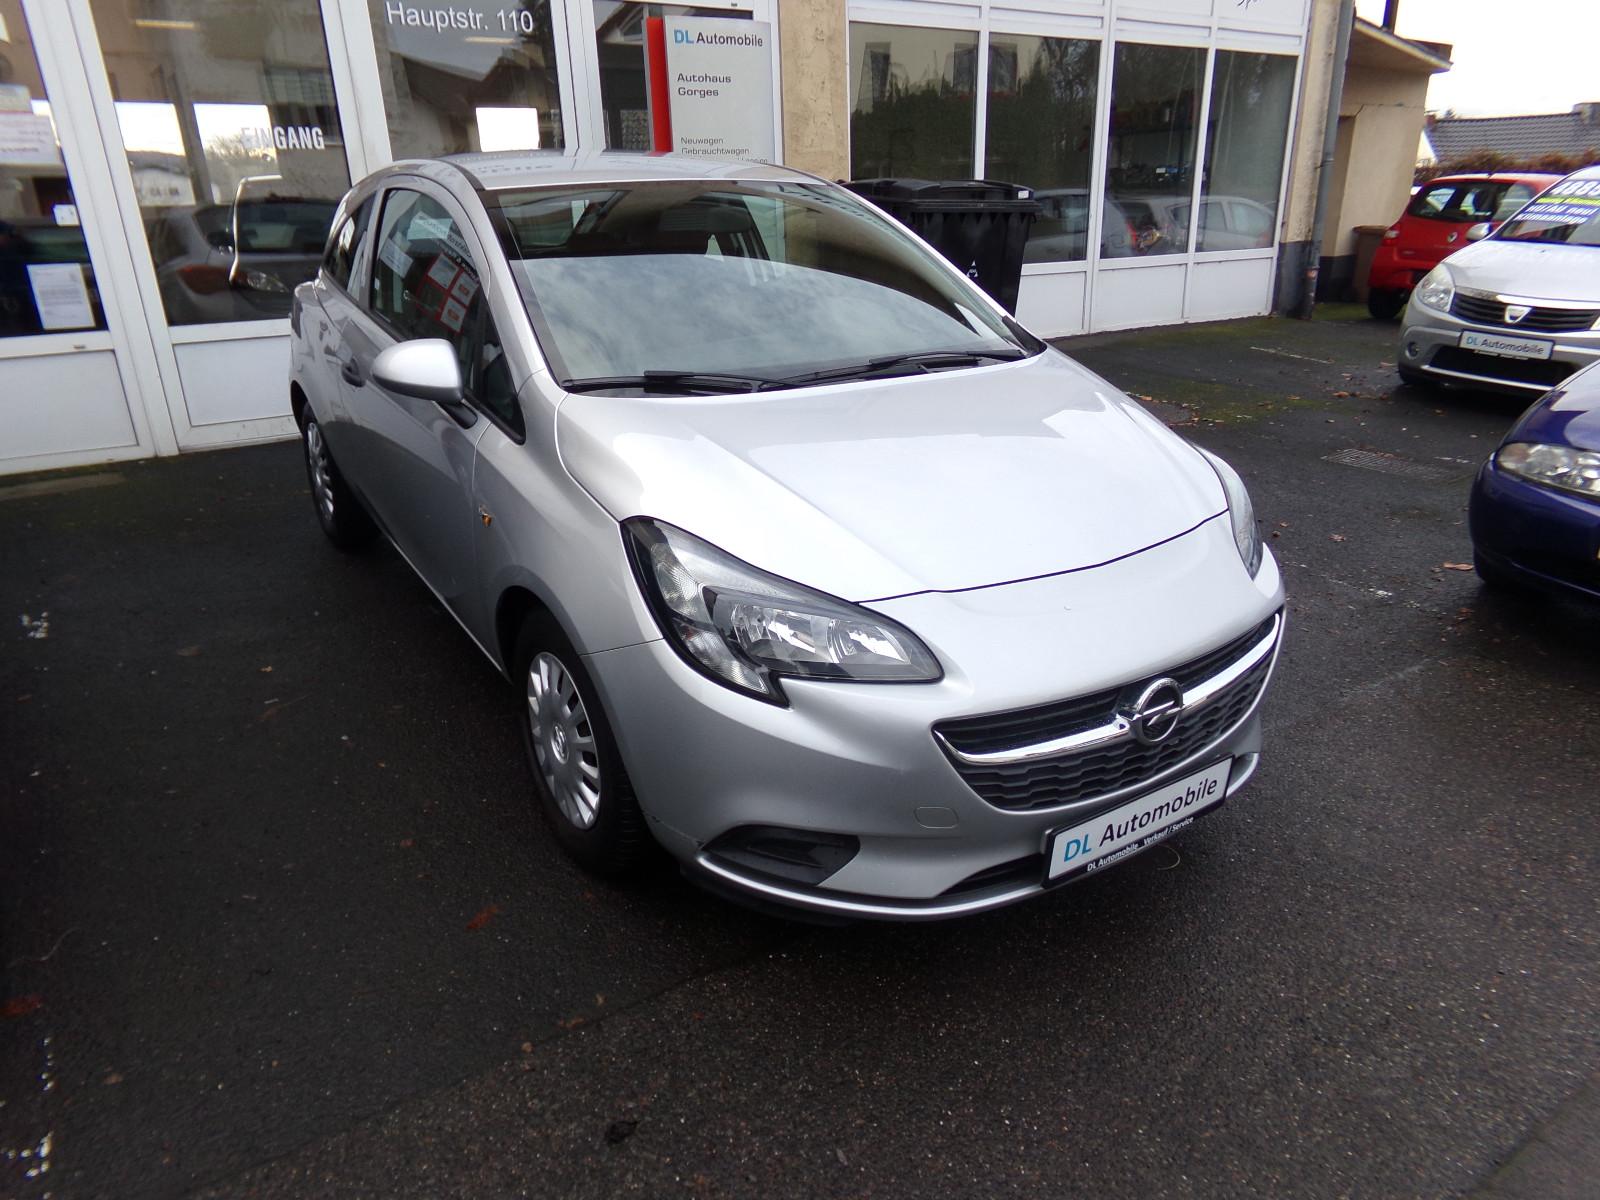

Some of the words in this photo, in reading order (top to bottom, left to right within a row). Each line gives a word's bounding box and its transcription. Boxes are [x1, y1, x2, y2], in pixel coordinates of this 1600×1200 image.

[386, 1, 488, 33] Hauptstr.
[496, 8, 533, 33] 110
[673, 29, 695, 44] DL
[696, 31, 763, 47] Automobile
[677, 73, 731, 83] Autohaus
[678, 87, 719, 98] Gorges
[240, 126, 325, 150] EINGANG
[680, 136, 724, 146] Neuwagen
[681, 147, 750, 155] Gebrauchtwagen
[1480, 338, 1544, 355] Automobile
[1063, 834, 1092, 862] DL
[1099, 778, 1218, 848] Automobile
[1098, 843, 1139, 867] Automobile
